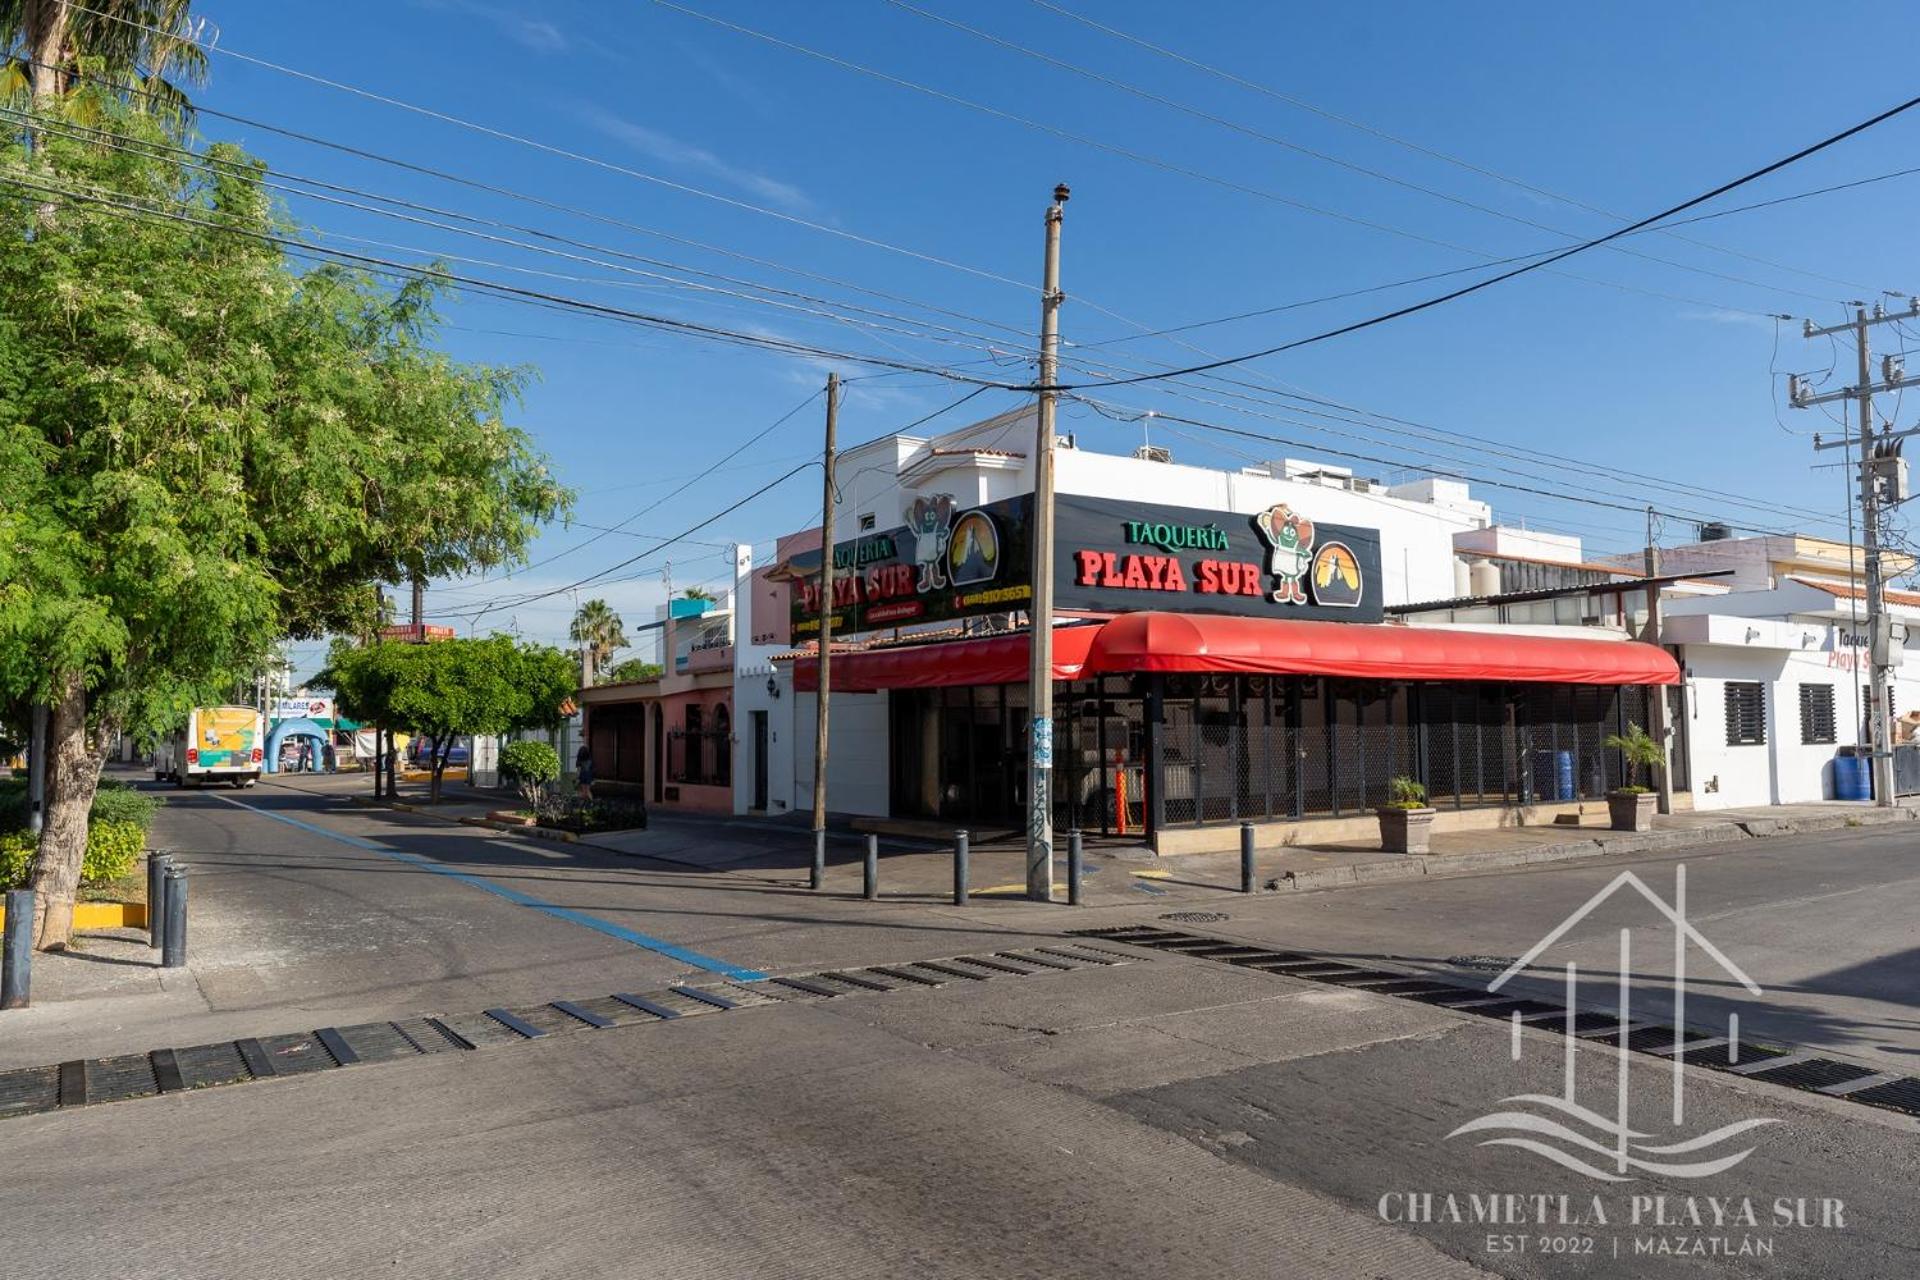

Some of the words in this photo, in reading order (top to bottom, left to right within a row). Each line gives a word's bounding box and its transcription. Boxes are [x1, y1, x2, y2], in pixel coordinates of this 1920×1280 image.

[1126, 521, 1230, 552] TAQUERÍA
[866, 563, 915, 600] SUR
[1078, 550, 1187, 592] PLAYA
[1199, 559, 1264, 596] SUR
